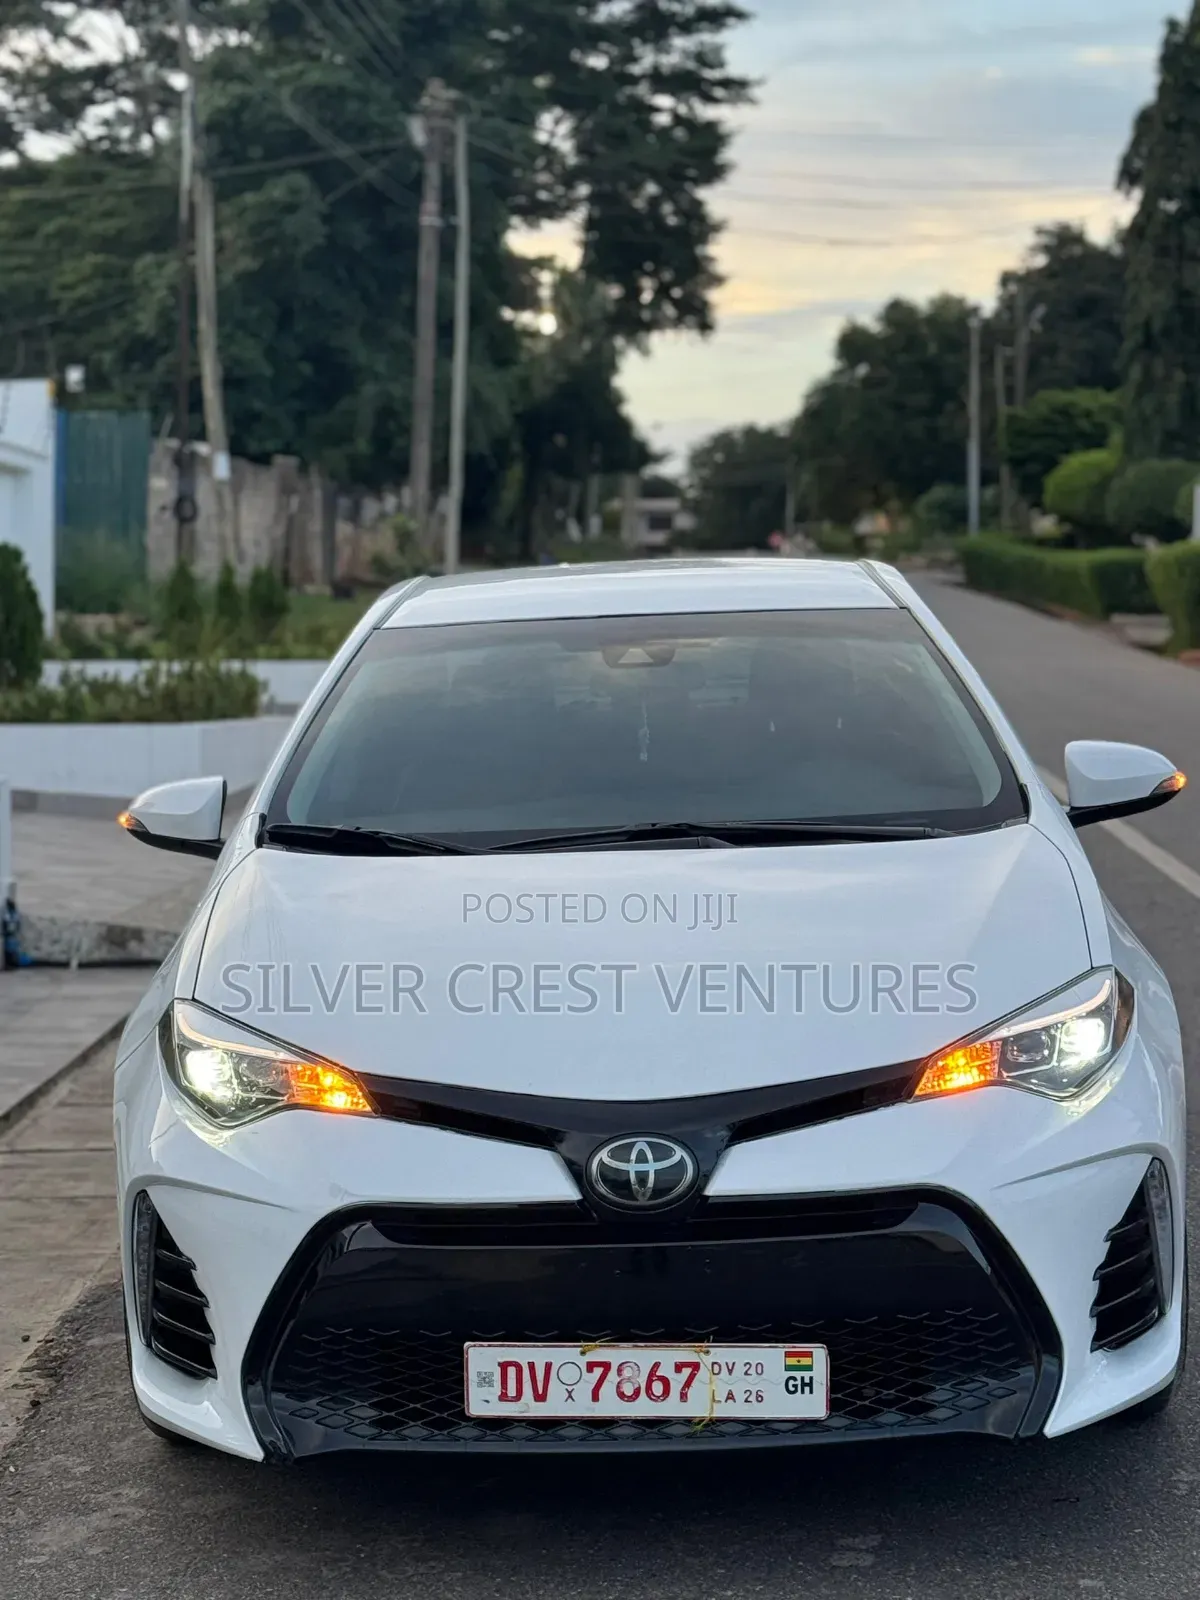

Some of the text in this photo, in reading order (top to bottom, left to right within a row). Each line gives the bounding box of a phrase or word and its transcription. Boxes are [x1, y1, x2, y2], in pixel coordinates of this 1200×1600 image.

[711, 1361, 765, 1377] DV 20
[497, 1360, 701, 1403] DV 7867
[784, 1375, 814, 1396] GH
[711, 1389, 765, 1404] LA 26
